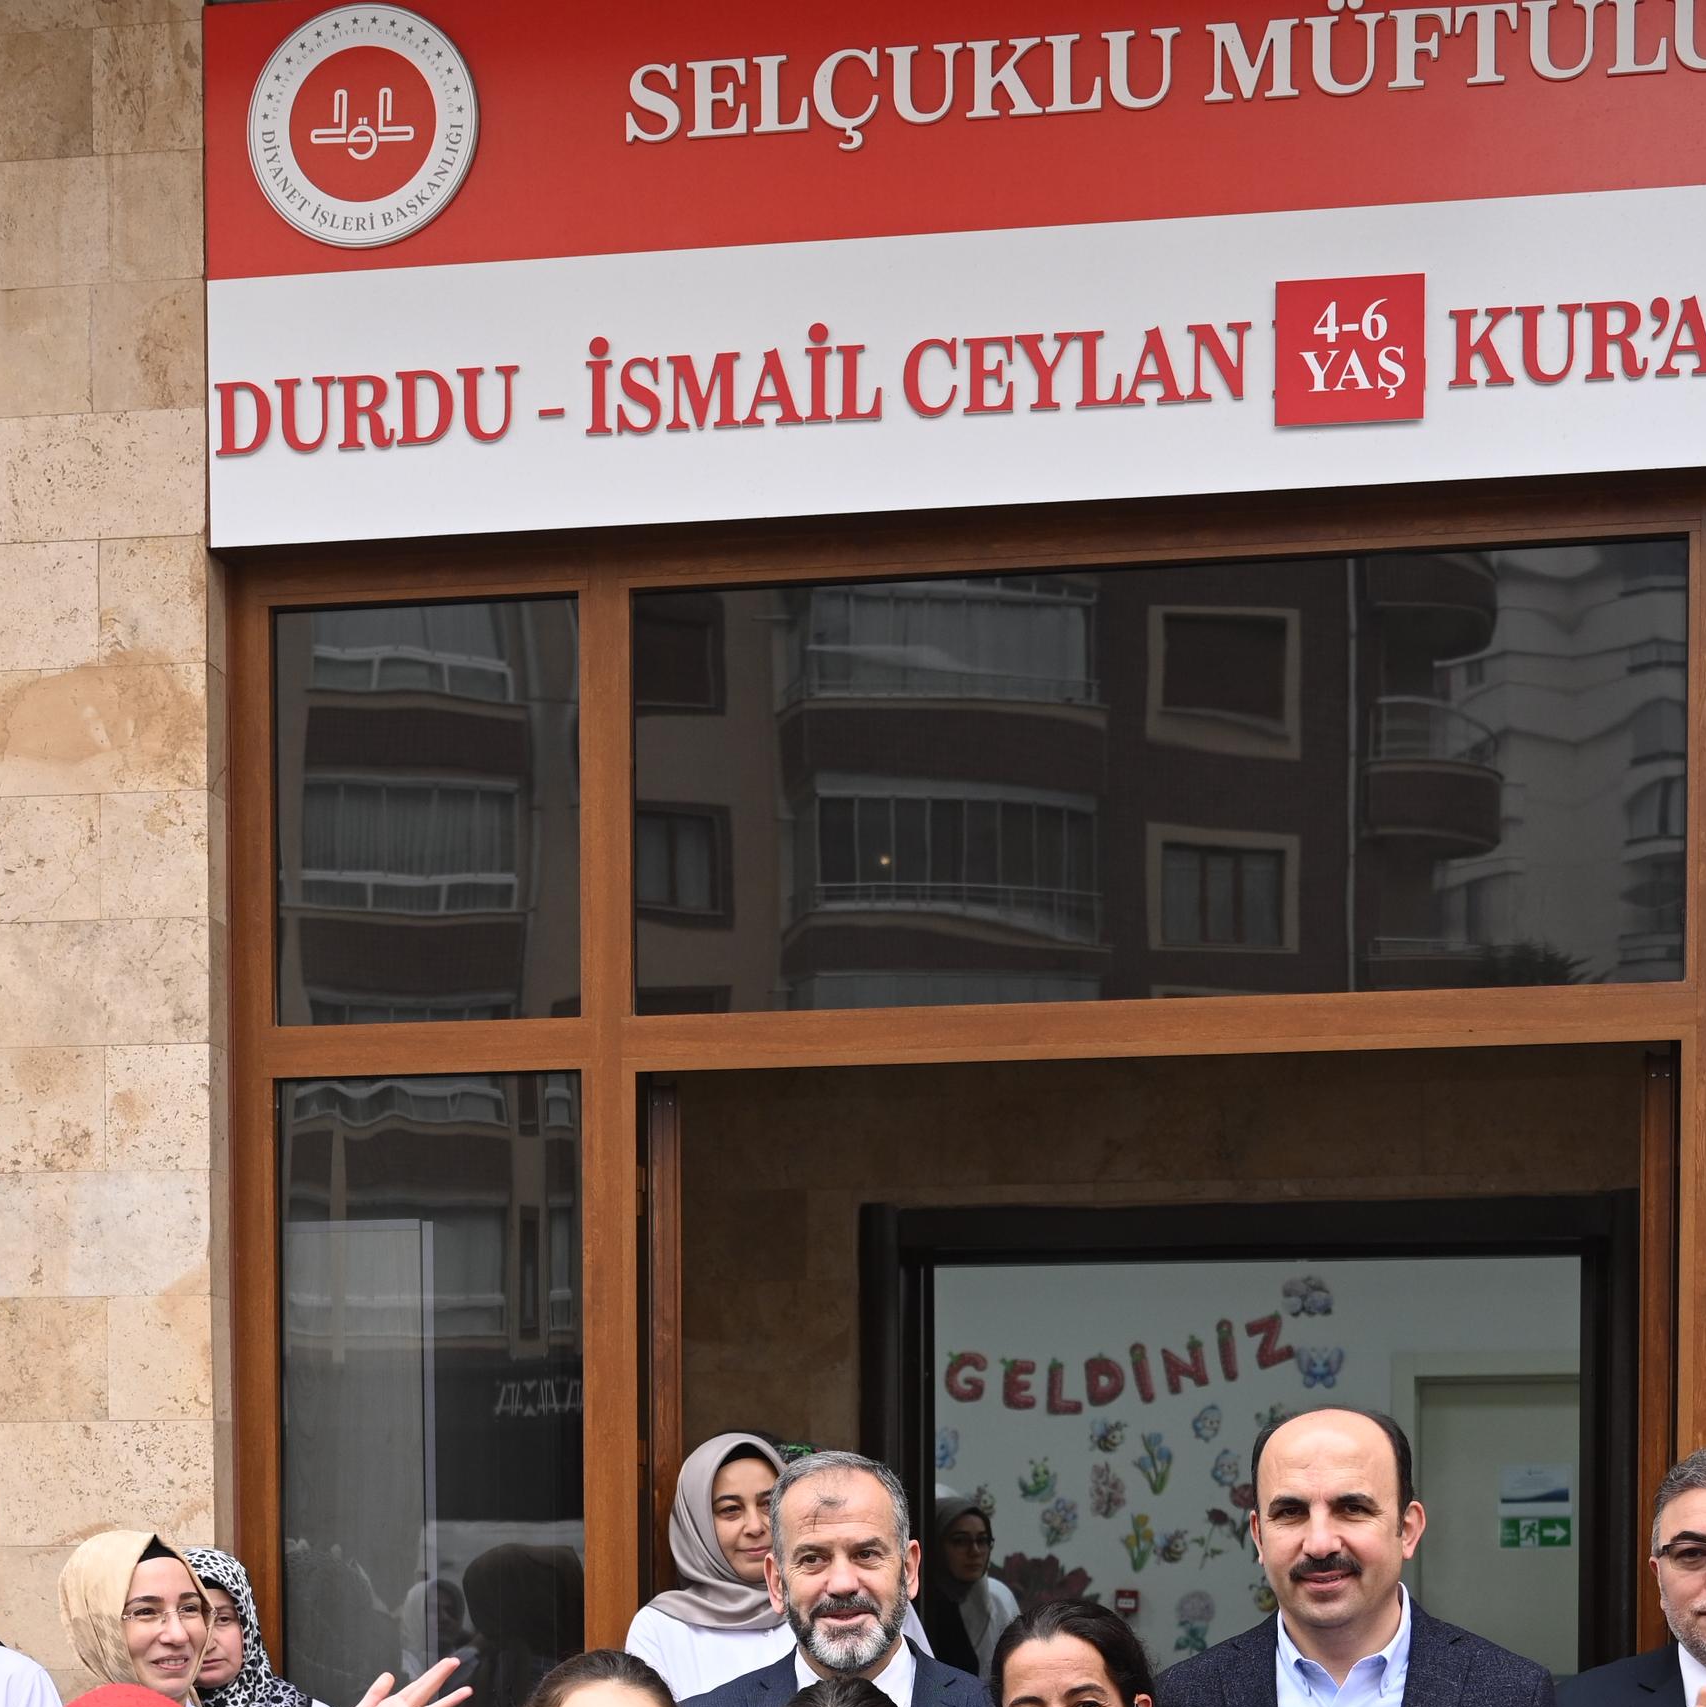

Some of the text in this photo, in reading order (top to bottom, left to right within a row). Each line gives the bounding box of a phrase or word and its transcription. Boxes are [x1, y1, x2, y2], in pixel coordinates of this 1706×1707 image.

[626, 27, 1181, 150] SELÇUKLU
[261, 122, 464, 232] DİYANET İŞLERİ BAŞKANLIĞI
[1298, 346, 1406, 400] YAŞ
[1313, 298, 1388, 343] 4-6
[215, 365, 519, 457] DURDU
[585, 323, 883, 436] İSMAİL
[903, 320, 1253, 418] CEYLAN
